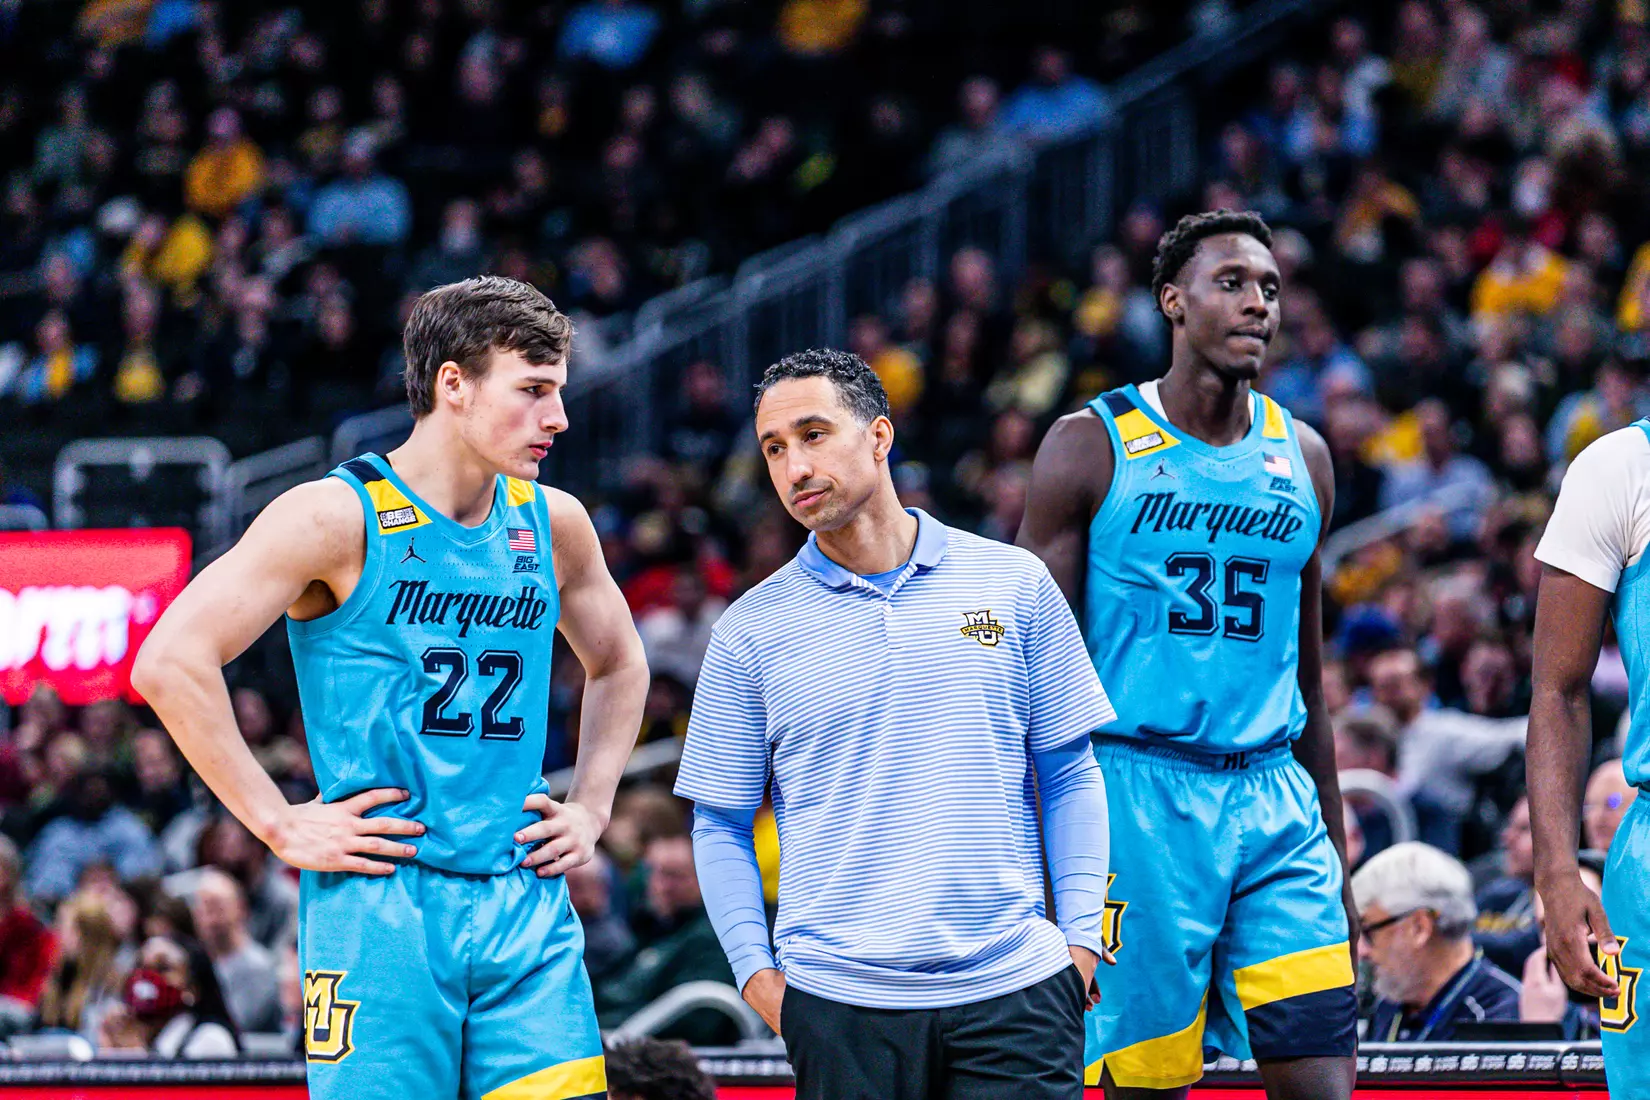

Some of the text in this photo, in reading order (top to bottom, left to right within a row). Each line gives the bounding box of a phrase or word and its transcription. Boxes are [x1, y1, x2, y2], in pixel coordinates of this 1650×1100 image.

[382, 514, 417, 528] CHANGE
[1130, 491, 1304, 543] Marquette
[513, 563, 540, 571] EAST
[516, 555, 534, 564] BIG
[385, 579, 547, 638] Marquette
[1165, 552, 1270, 642] 35
[419, 647, 525, 741] 22
